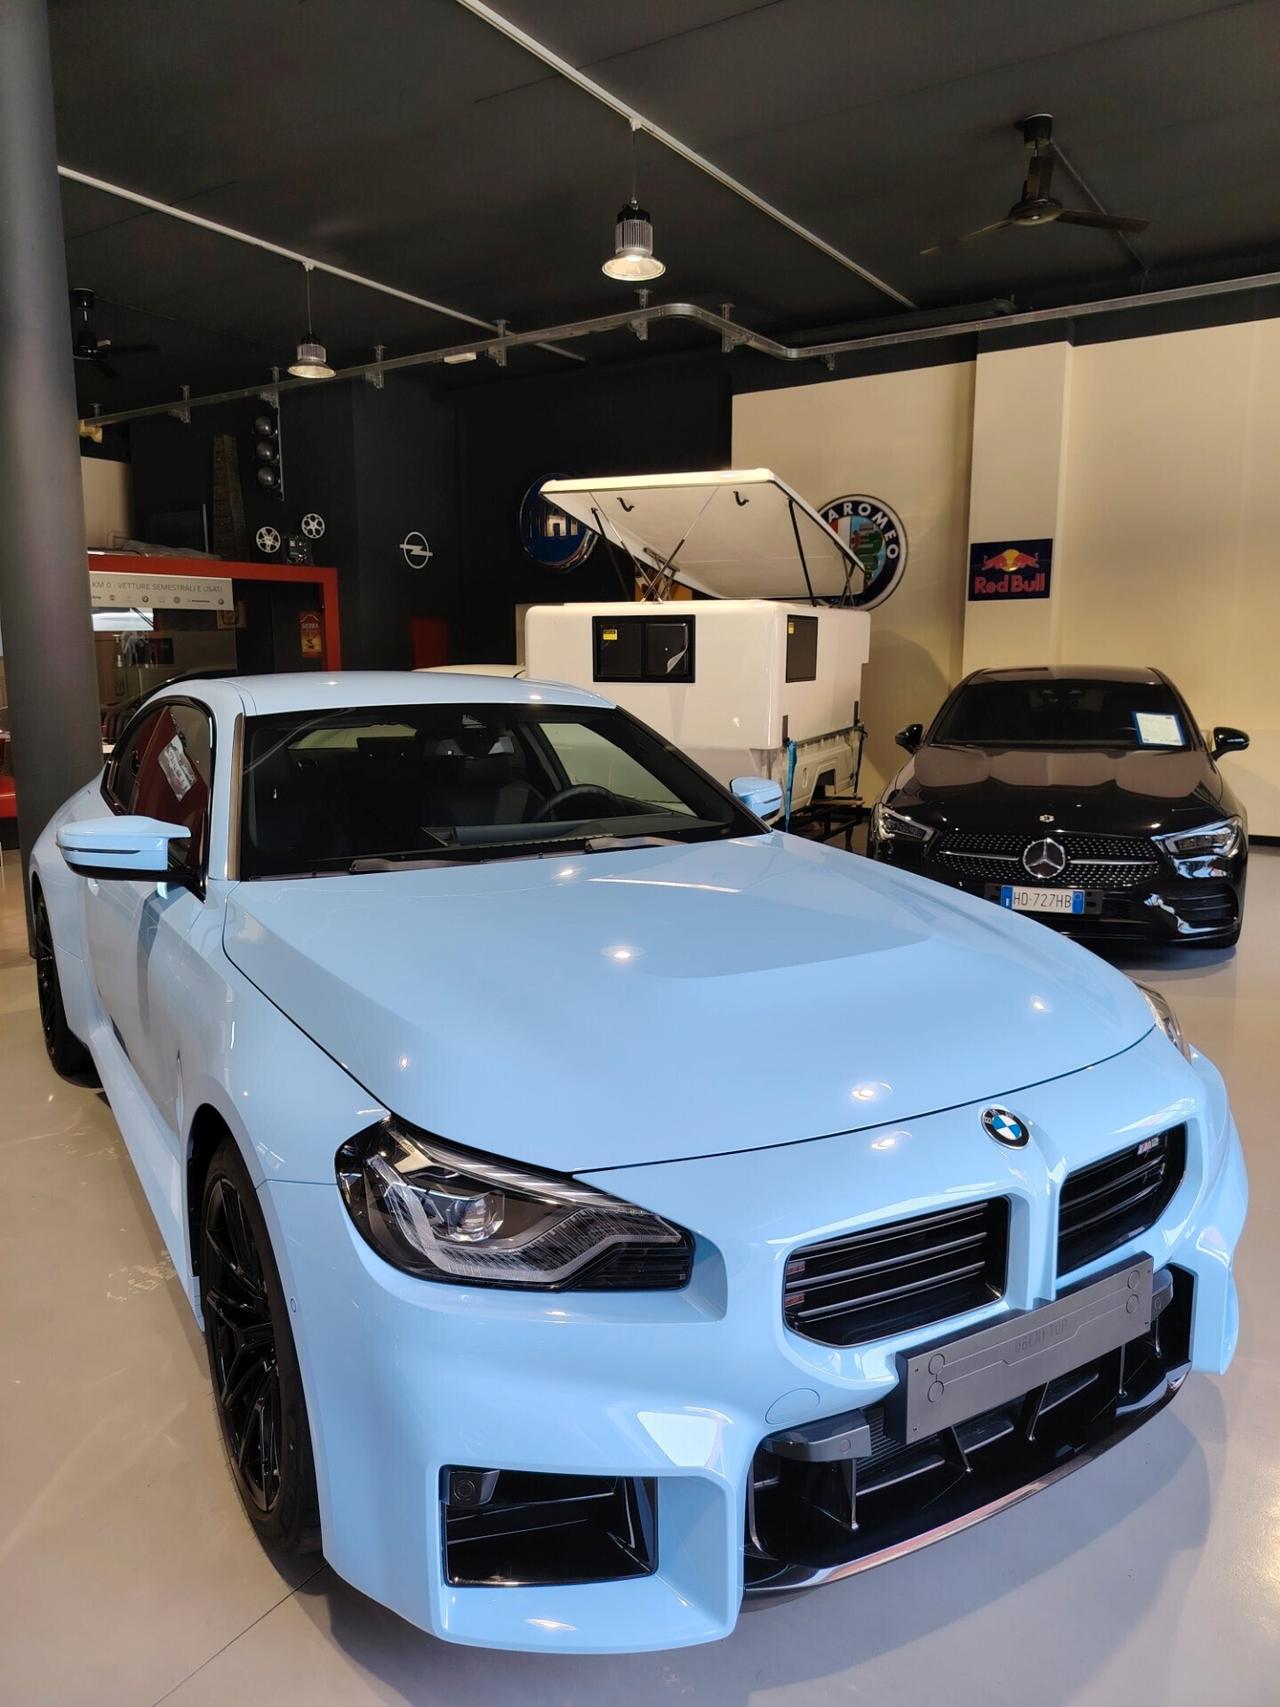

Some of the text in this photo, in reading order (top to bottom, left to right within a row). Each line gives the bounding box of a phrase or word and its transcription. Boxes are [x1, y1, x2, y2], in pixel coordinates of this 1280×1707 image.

[118, 582, 150, 591] VETTURE
[151, 583, 195, 593] SEMESTRALI
[202, 586, 223, 594] USATI
[974, 573, 1045, 594] Red Bull
